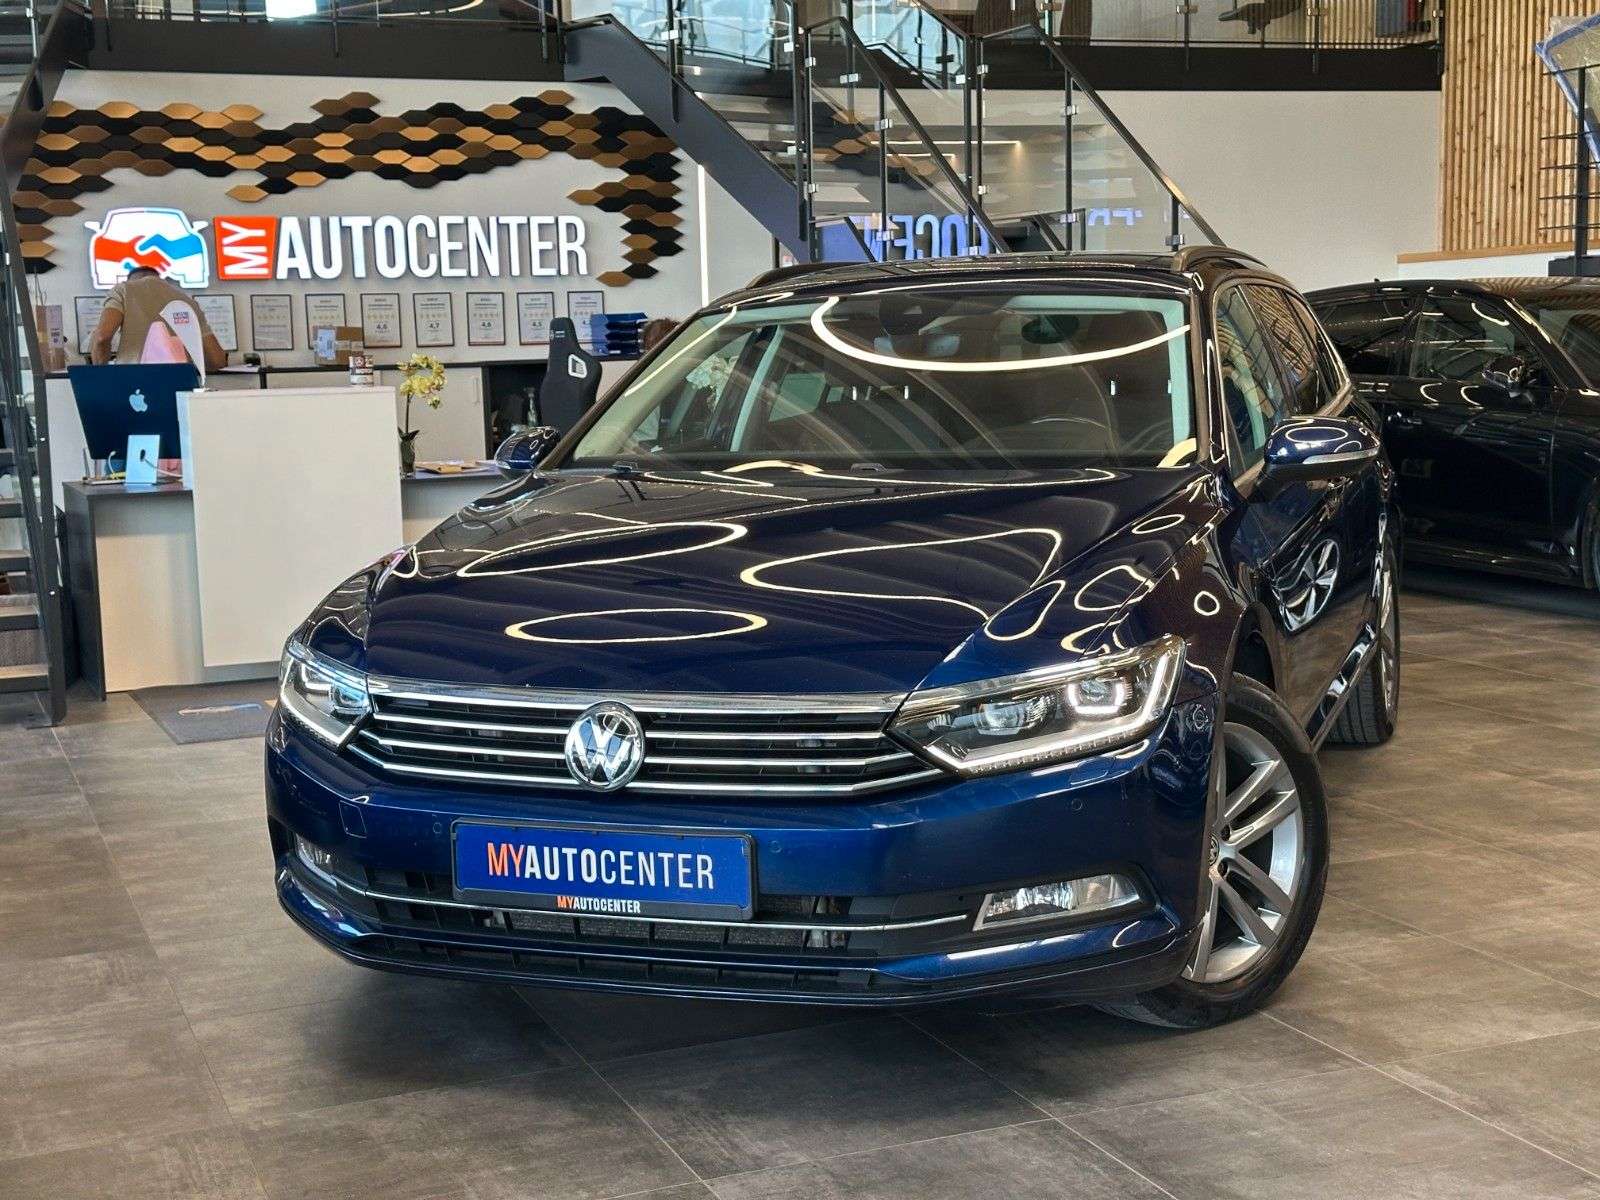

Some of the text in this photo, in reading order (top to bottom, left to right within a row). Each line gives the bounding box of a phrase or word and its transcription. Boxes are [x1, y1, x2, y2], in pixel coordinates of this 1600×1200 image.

[220, 215, 588, 279] MY AUTOCENTER
[567, 706, 643, 788] VW
[487, 842, 714, 889] MYAUTOCENTER
[556, 896, 641, 913] MYAUTOCENTER
